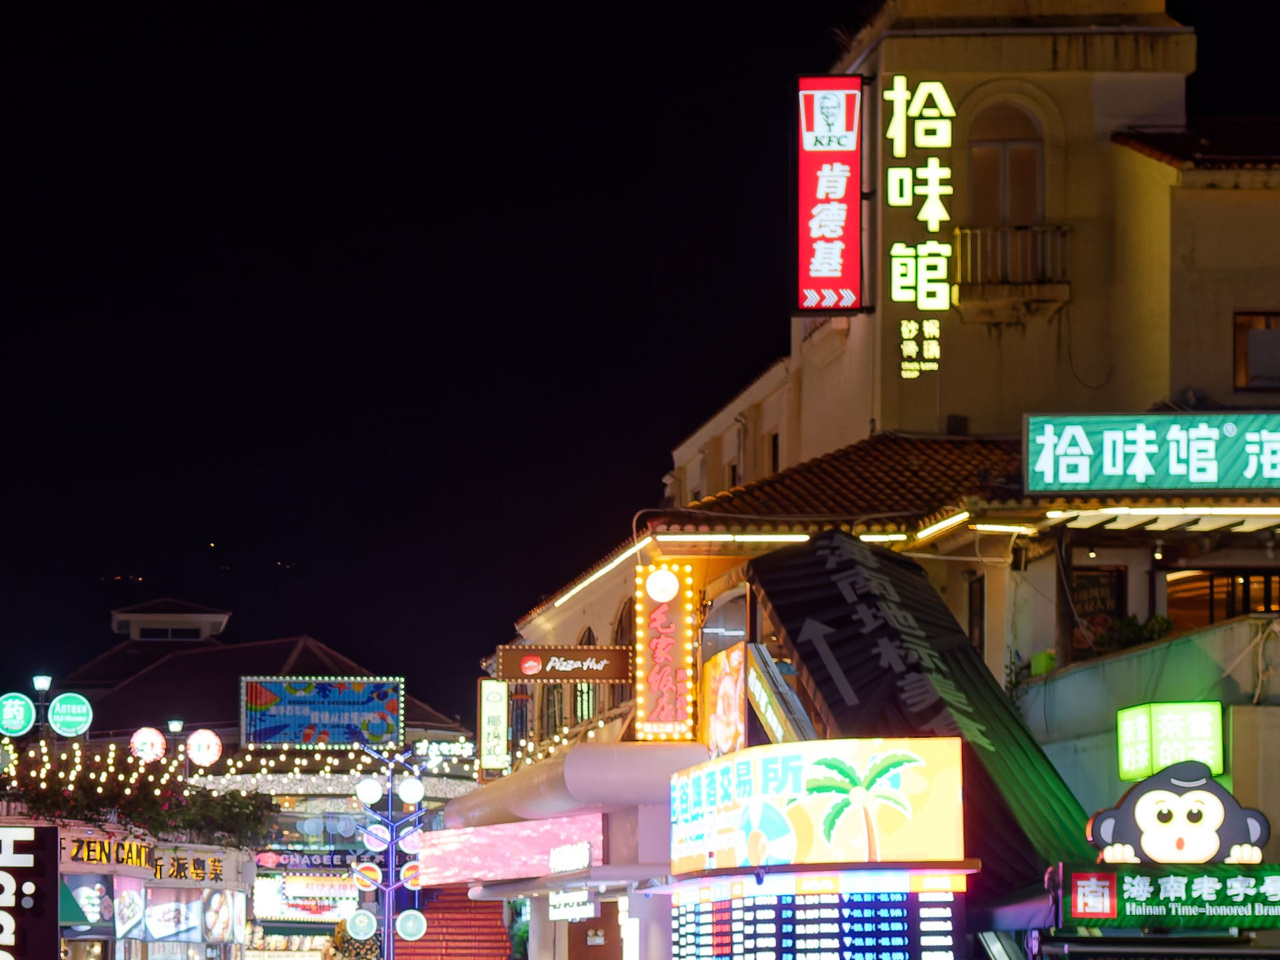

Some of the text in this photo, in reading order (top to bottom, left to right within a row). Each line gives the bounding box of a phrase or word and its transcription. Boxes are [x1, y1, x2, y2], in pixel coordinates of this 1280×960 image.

[813, 134, 848, 148] KFC
[808, 162, 850, 278] 肯德基
[545, 655, 610, 672] Pizza Hut
[71, 838, 111, 864] ZEN
[280, 854, 341, 865] CHAGEE
[1122, 875, 1280, 902] 海南老字号
[1125, 902, 1166, 916] Hainan
